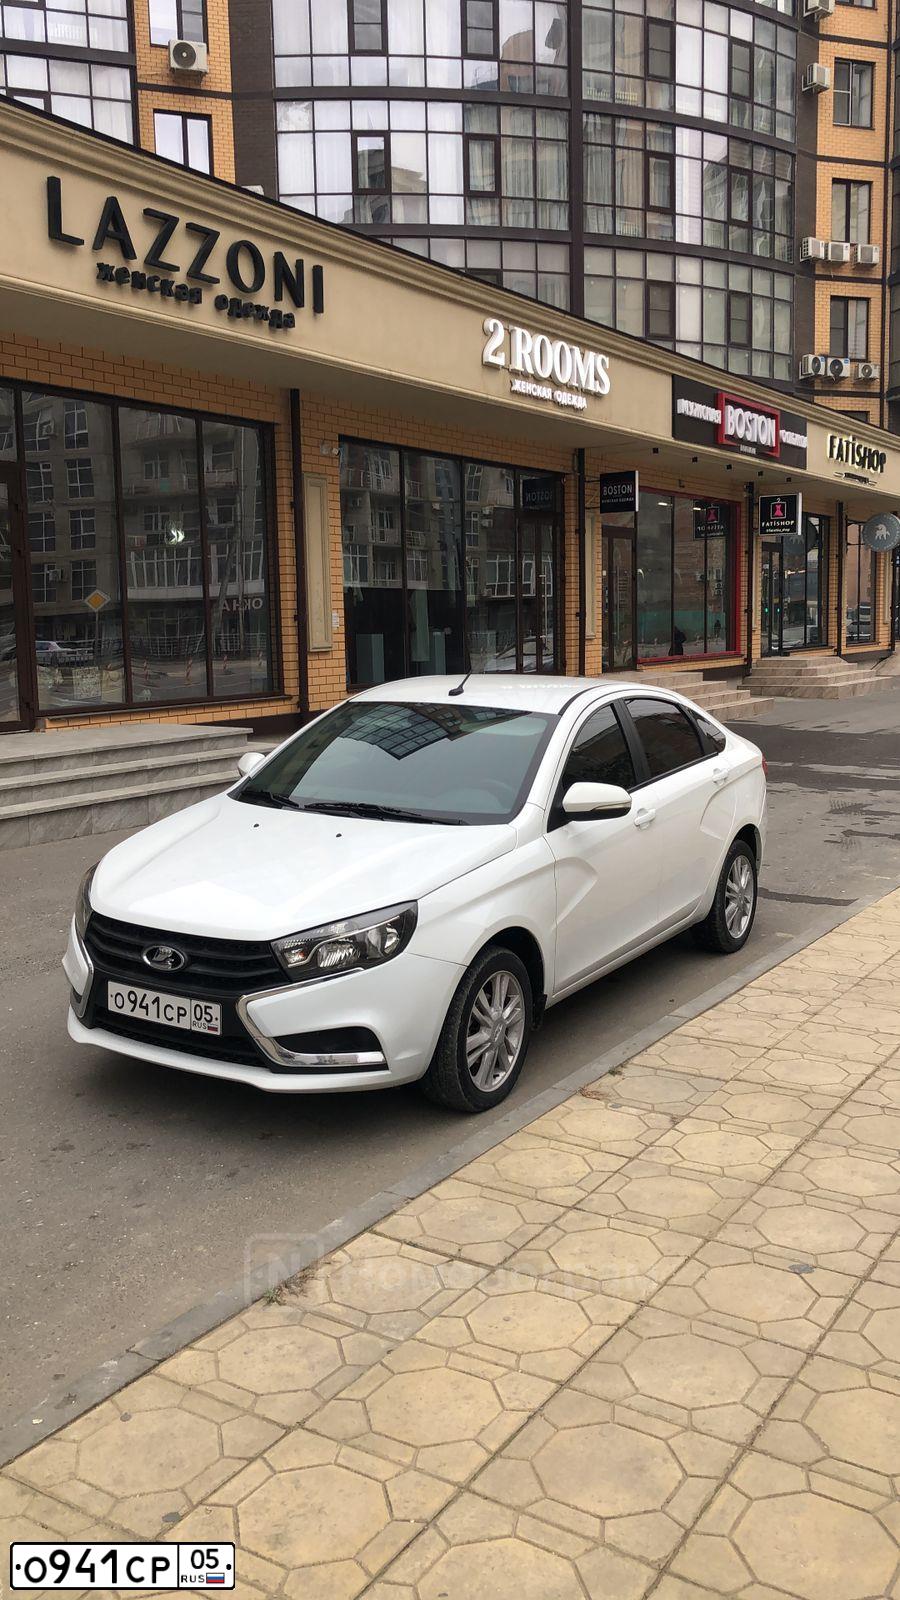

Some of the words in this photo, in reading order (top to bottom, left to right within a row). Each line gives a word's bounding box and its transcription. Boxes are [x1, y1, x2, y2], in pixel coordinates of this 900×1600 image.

[47, 176, 324, 314] LAZZONI
[96, 262, 203, 305] женская
[214, 294, 296, 329] одежда
[482, 318, 506, 367] 2
[508, 324, 611, 396] ROOMS
[511, 378, 552, 401] ЖЕНСКАЯ
[553, 390, 588, 411] ОДЕЖДА
[723, 404, 776, 448] BOSTON
[603, 484, 633, 497] BOSTON
[114, 990, 187, 1024] О941СР
[193, 1003, 213, 1023] 05
[192, 1020, 207, 1030] RUS
